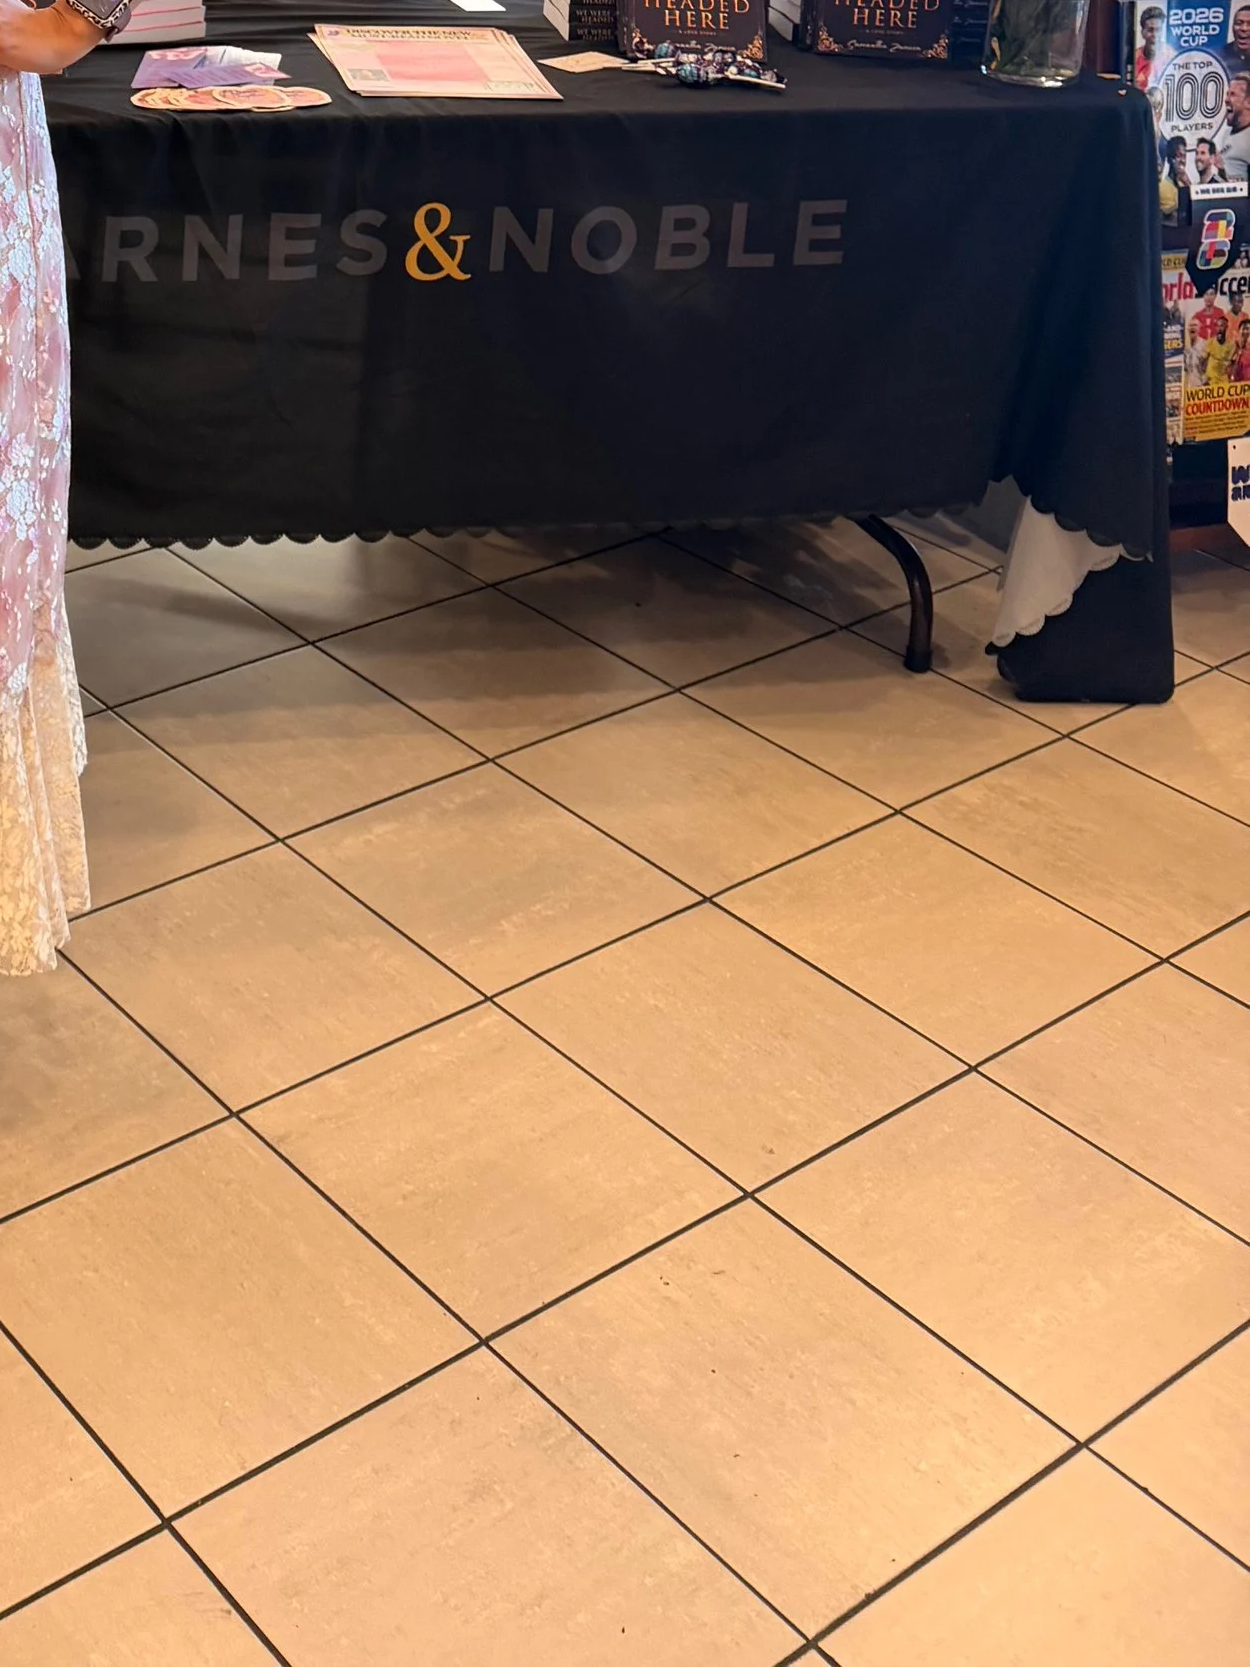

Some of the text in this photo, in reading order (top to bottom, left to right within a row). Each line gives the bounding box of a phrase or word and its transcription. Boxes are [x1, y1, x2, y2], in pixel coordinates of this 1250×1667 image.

[664, 10, 730, 30] HERE
[852, 7, 918, 29] HERE
[1169, 7, 1225, 25] 2026
[1170, 24, 1220, 37] WORLD
[1181, 36, 1209, 47] CUP
[1173, 60, 1214, 71] THE TOP
[1165, 71, 1225, 123] 100
[1171, 121, 1214, 133] PLAYERS
[404, 201, 472, 282] &
[489, 199, 849, 275] NOBLE
[1186, 385, 1250, 402] WORLD CUP
[1185, 396, 1250, 417] COUNTDOWN
